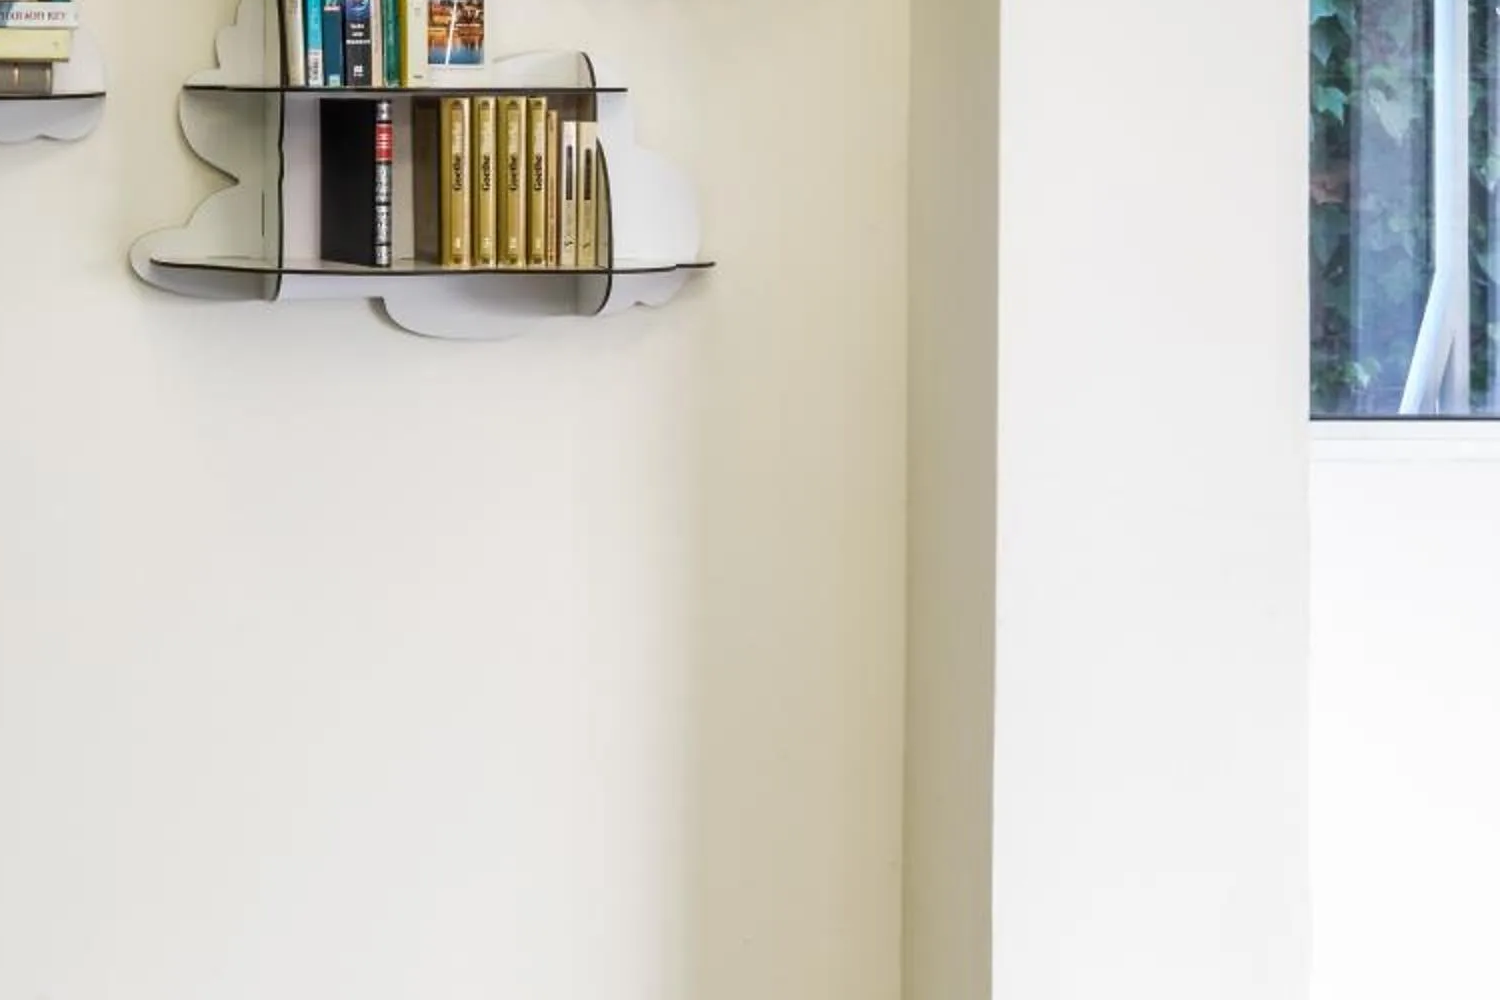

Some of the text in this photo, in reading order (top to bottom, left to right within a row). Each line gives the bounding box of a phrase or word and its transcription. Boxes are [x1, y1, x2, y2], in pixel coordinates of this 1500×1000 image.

[452, 154, 463, 192] Goethe
[481, 154, 491, 192] Goethe
[508, 154, 518, 192] Goethe
[533, 154, 542, 192] Goethe
